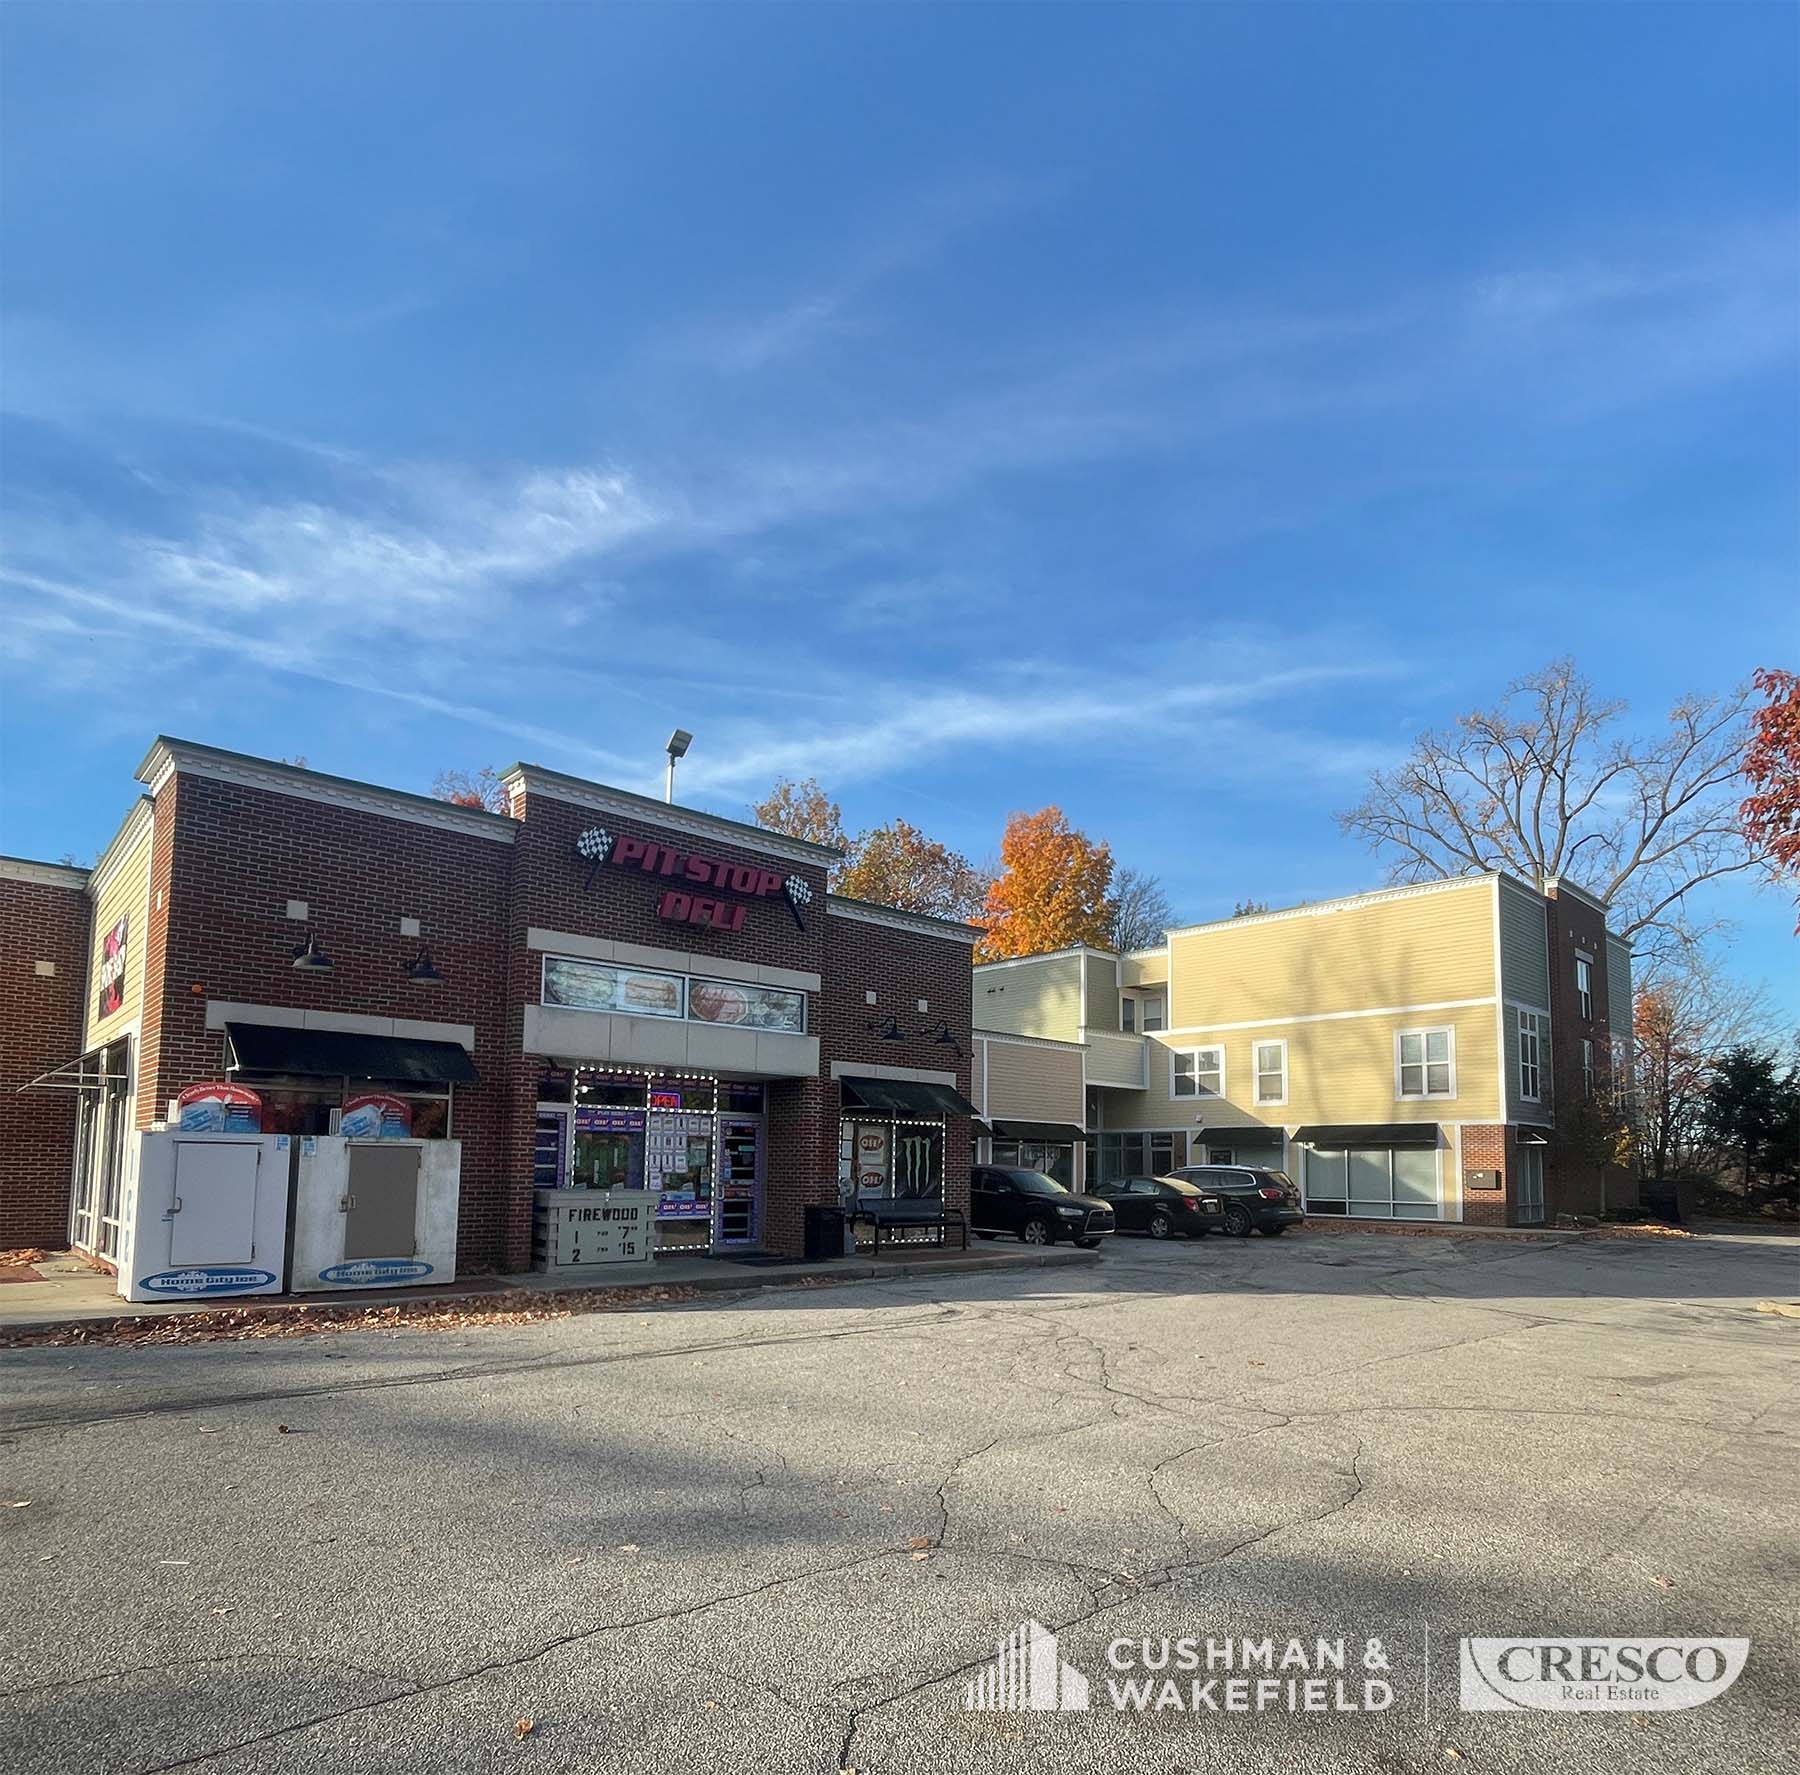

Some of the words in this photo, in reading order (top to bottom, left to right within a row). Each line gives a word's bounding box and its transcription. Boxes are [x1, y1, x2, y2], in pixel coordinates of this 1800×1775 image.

[611, 835, 679, 876] PIT
[684, 854, 784, 897] STOP
[659, 891, 747, 932] DELI
[568, 1207, 638, 1222] FIREWOOD
[572, 1248, 580, 1262] 2
[160, 1278, 203, 1286] Home
